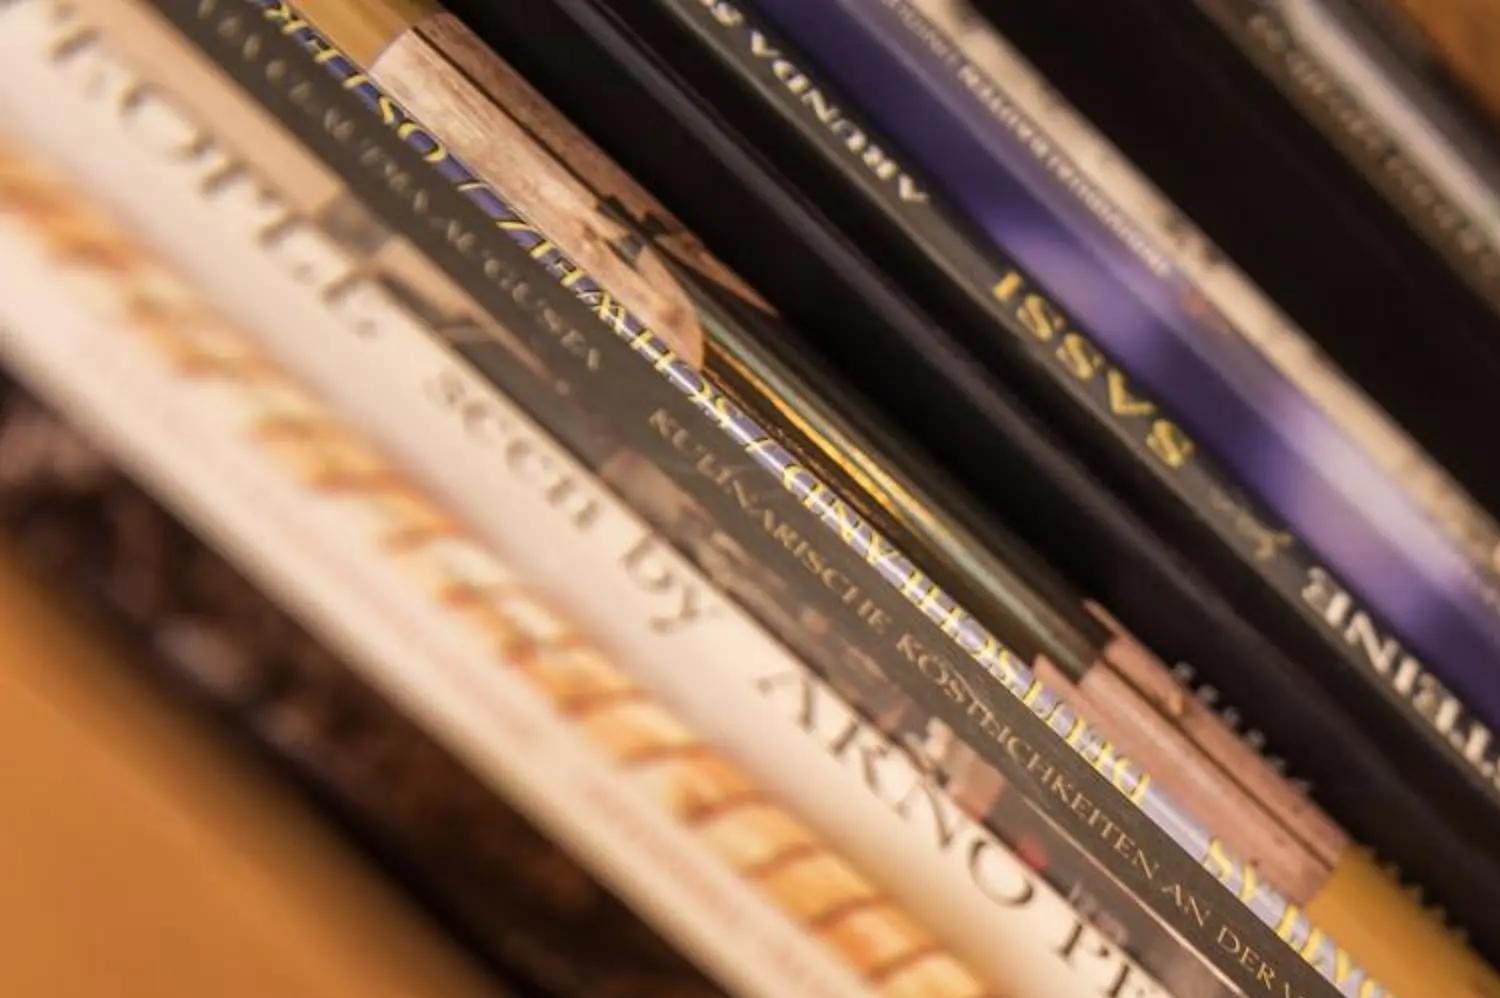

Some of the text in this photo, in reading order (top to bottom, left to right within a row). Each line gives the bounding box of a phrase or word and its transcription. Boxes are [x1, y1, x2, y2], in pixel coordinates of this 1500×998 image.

[750, 29, 931, 205] ARUNDA
[992, 270, 1196, 470] SASSI
[424, 367, 600, 538] seen
[618, 538, 710, 634] by
[755, 664, 1036, 909] ARNO
[648, 407, 896, 635] KULINARISCHE
[896, 631, 1165, 888] KÖSTLICHKEITEN
[1161, 880, 1211, 929] AN
[1216, 923, 1280, 993] DER
